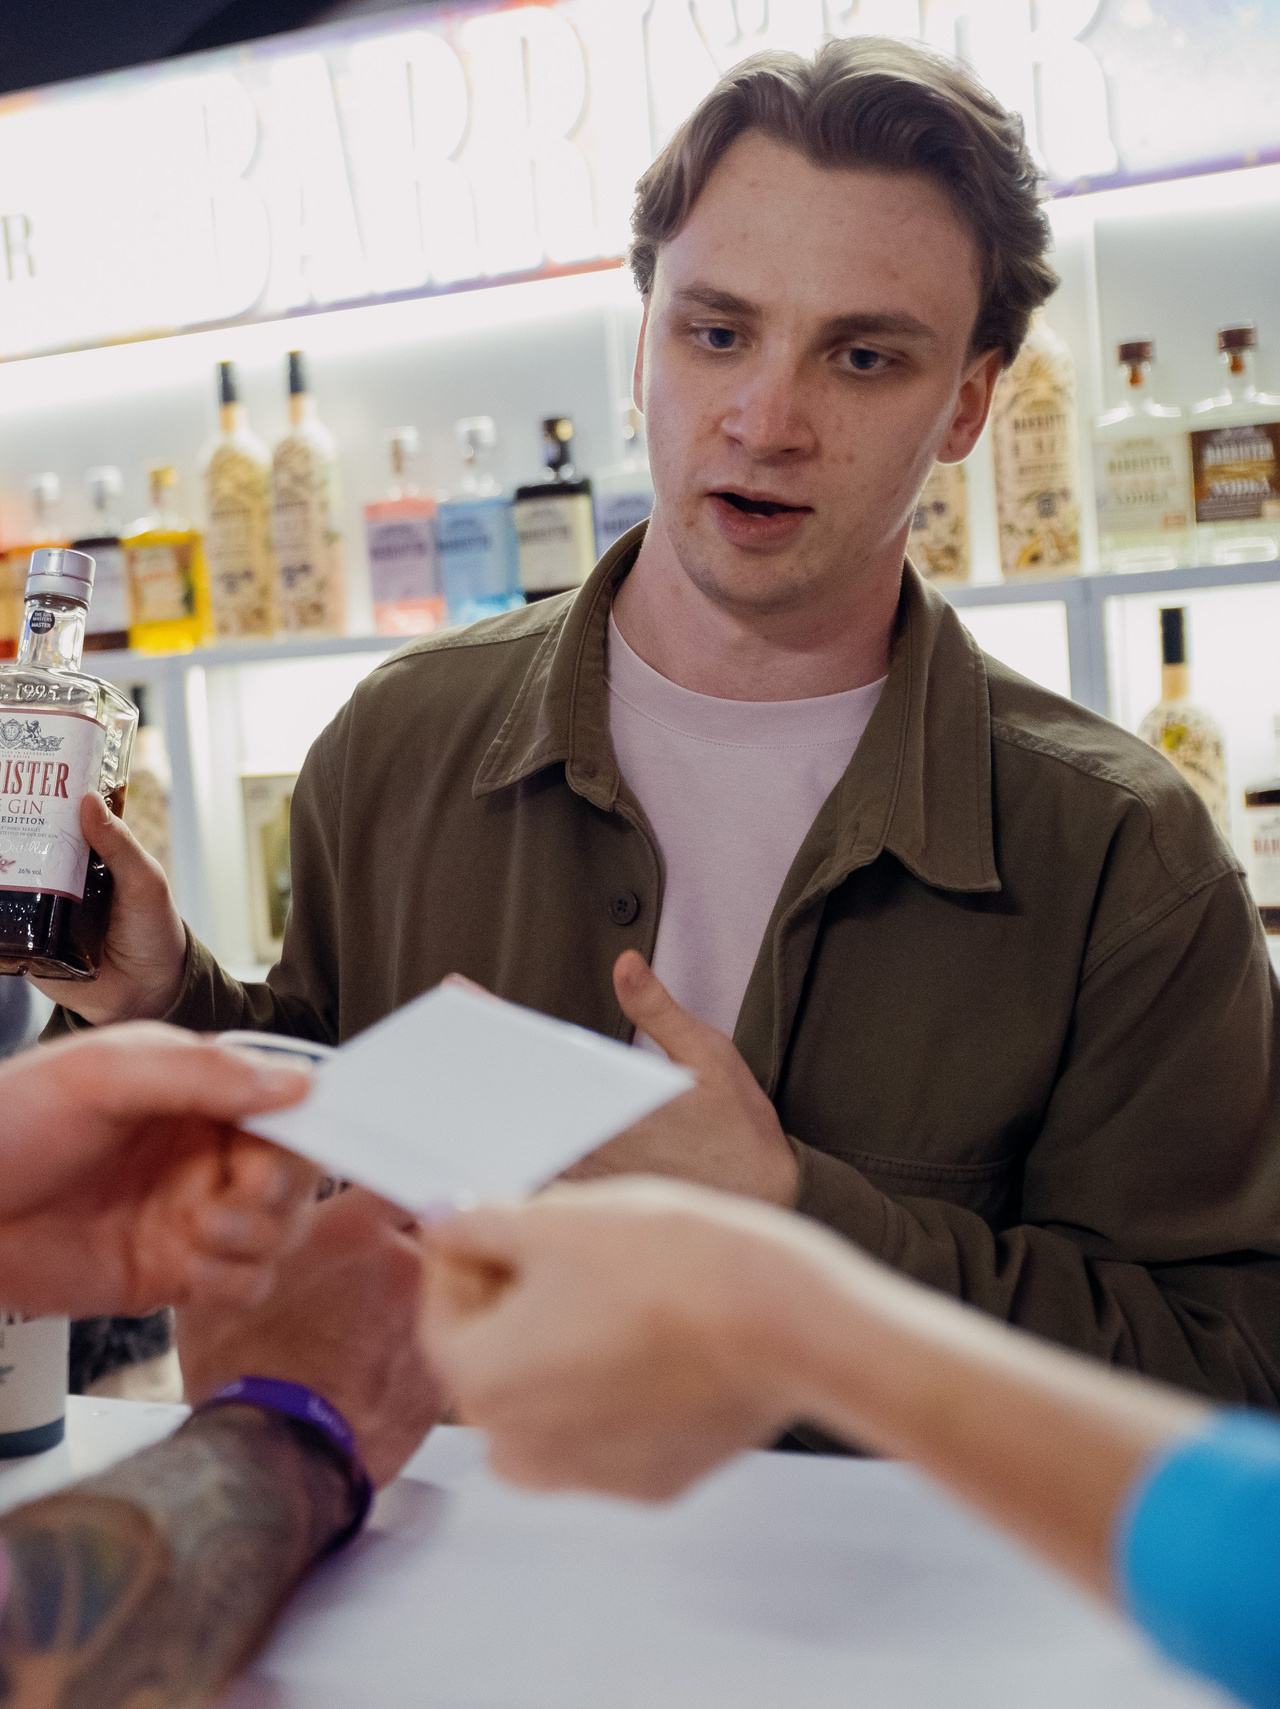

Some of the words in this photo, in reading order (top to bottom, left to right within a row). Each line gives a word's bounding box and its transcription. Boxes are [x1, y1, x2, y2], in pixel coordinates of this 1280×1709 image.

[16, 683, 60, 700] 1995
[8, 798, 44, 815] GIN
[1, 816, 46, 826] EDITION
[18, 867, 31, 875] 26%
